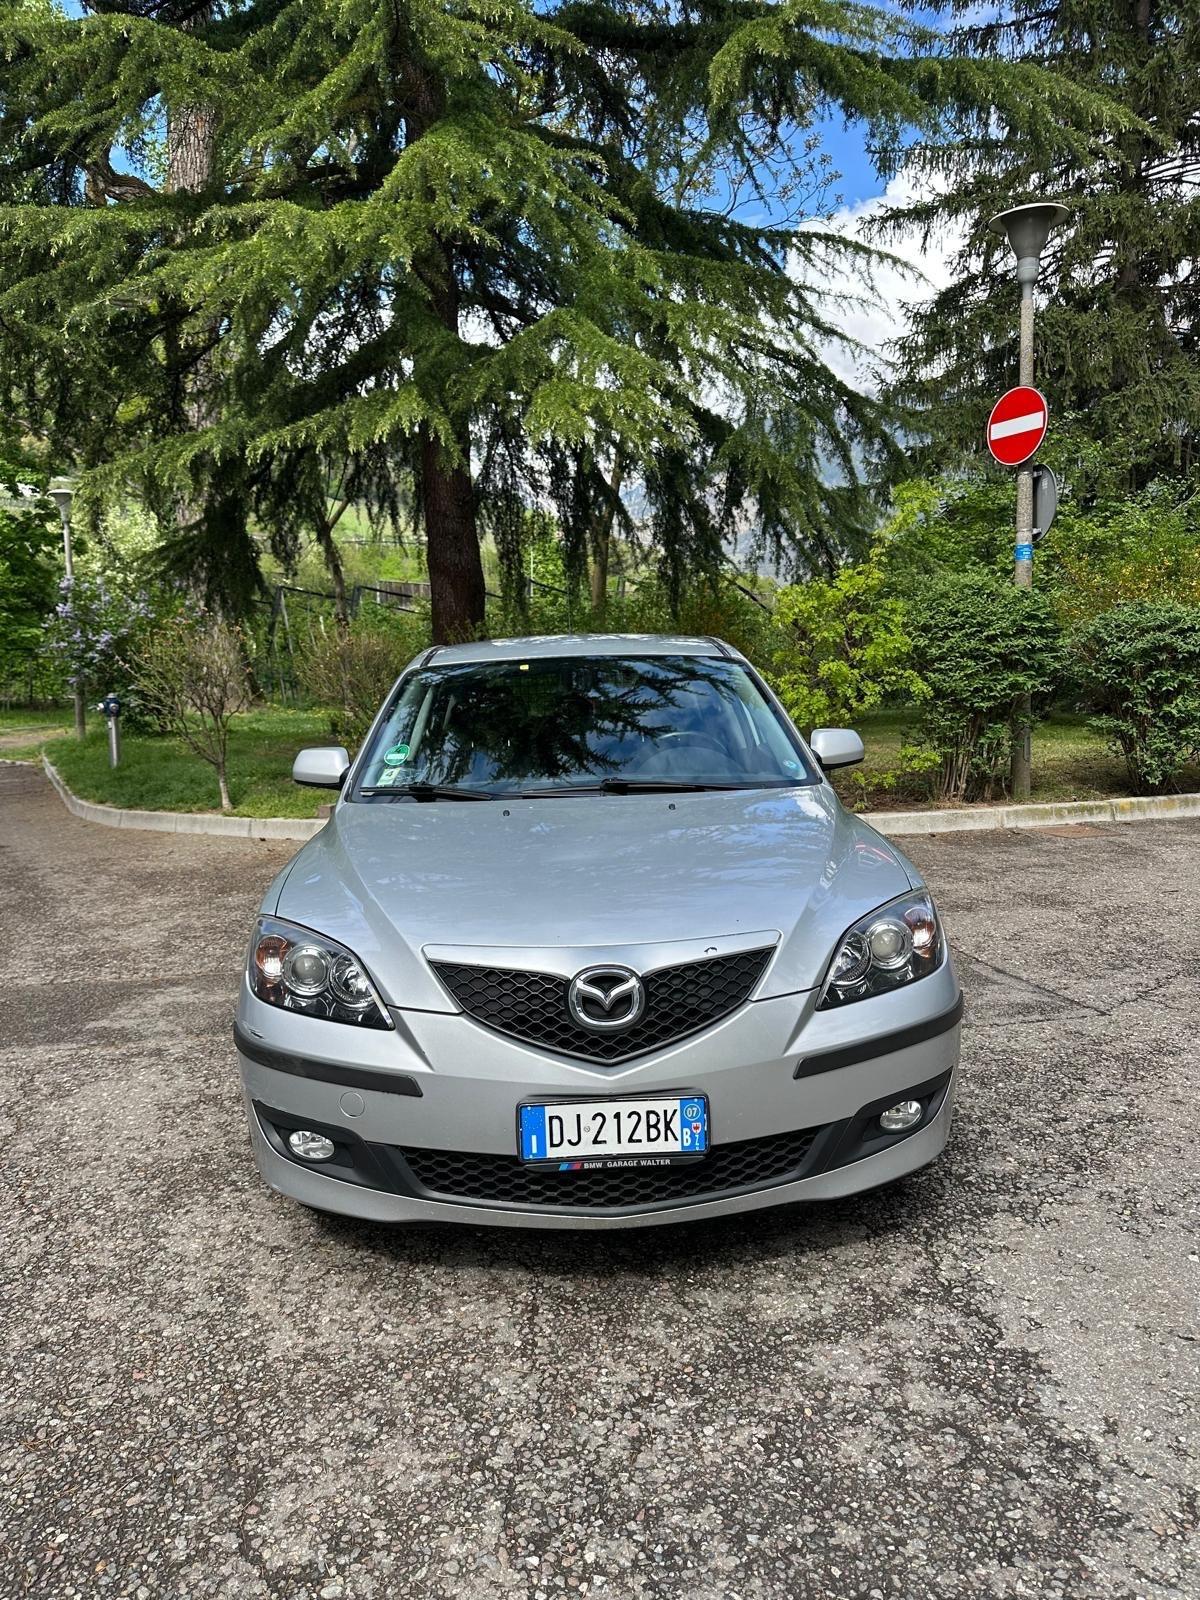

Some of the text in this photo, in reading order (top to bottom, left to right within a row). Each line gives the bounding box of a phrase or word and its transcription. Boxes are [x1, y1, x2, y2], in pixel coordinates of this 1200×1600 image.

[686, 1107, 697, 1117] 07
[606, 1160, 639, 1168] GARAGE
[640, 1158, 671, 1166] WALTER
